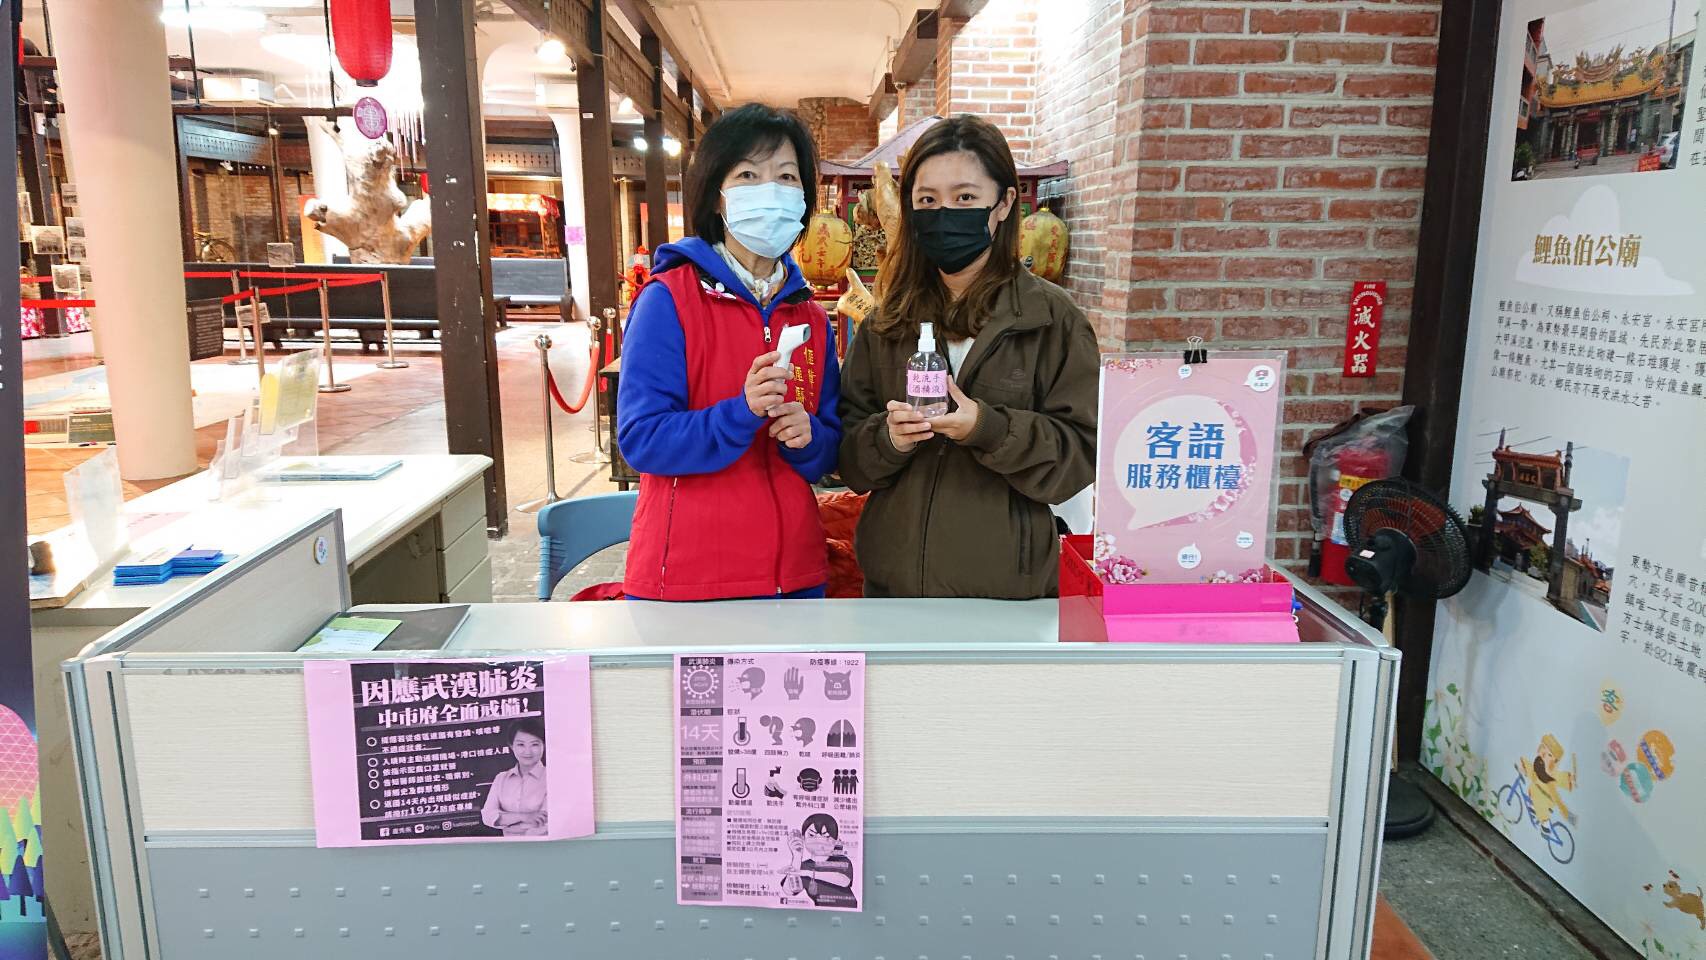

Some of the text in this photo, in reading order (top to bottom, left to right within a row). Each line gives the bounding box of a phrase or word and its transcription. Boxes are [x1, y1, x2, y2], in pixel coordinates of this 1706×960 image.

[1532, 234, 1642, 268] 鯉魚伯公廟
[1351, 305, 1376, 374] 滅火器
[1145, 421, 1225, 460] 客語
[1126, 464, 1240, 490] 服務櫃檯
[361, 665, 538, 707] 因應武漢肺炎
[378, 697, 529, 728] 中市府全面戒備!
[681, 723, 721, 742] 14天
